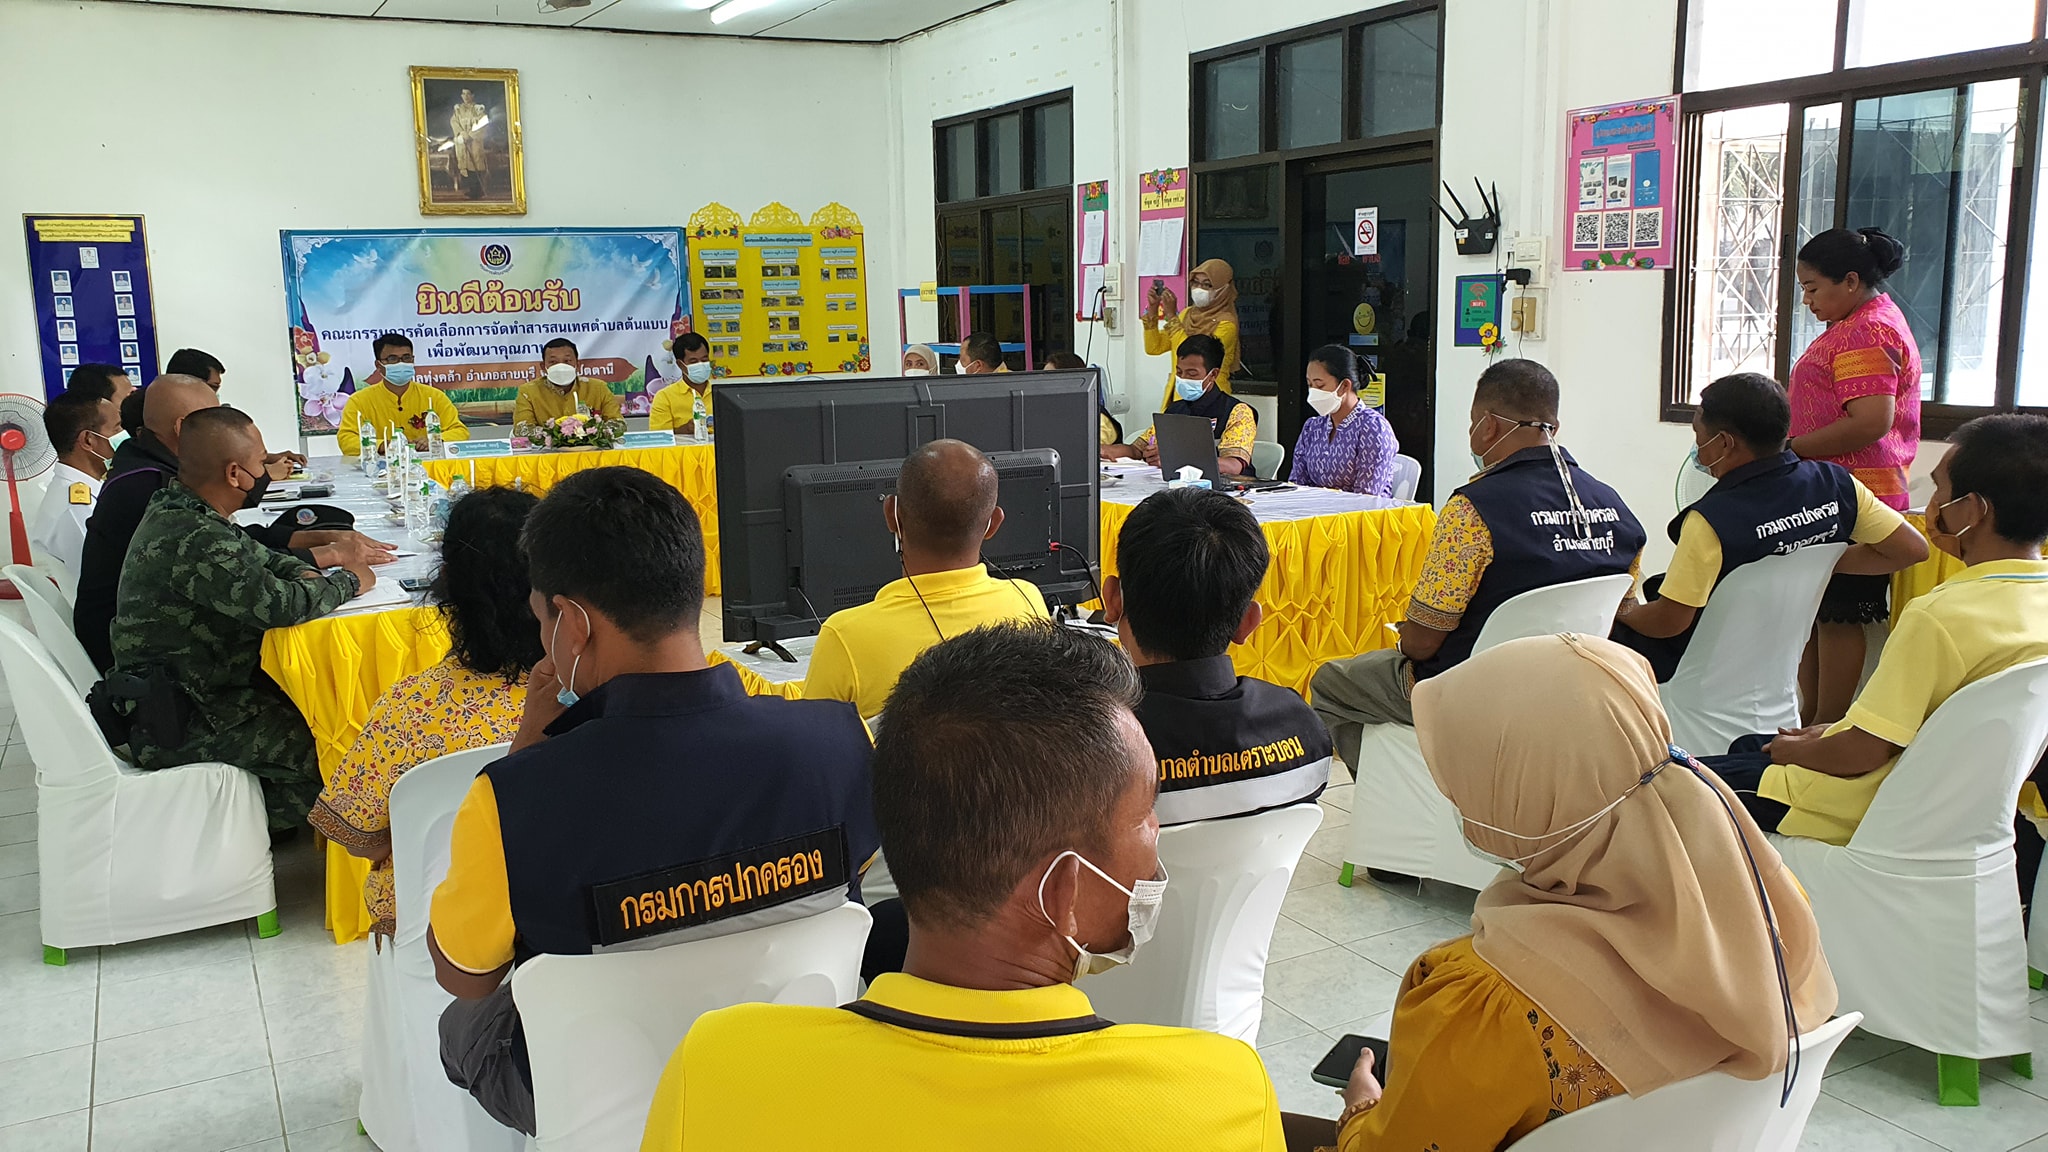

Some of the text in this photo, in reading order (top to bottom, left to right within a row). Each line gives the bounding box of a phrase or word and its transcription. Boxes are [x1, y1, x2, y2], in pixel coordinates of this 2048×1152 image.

[416, 278, 581, 315] ยินดีต้อนรับ
[412, 369, 462, 387] ลทุ่งคล้า
[466, 366, 536, 383] อำเภอสายบุรี
[620, 848, 824, 930] กรมการปกครอง
